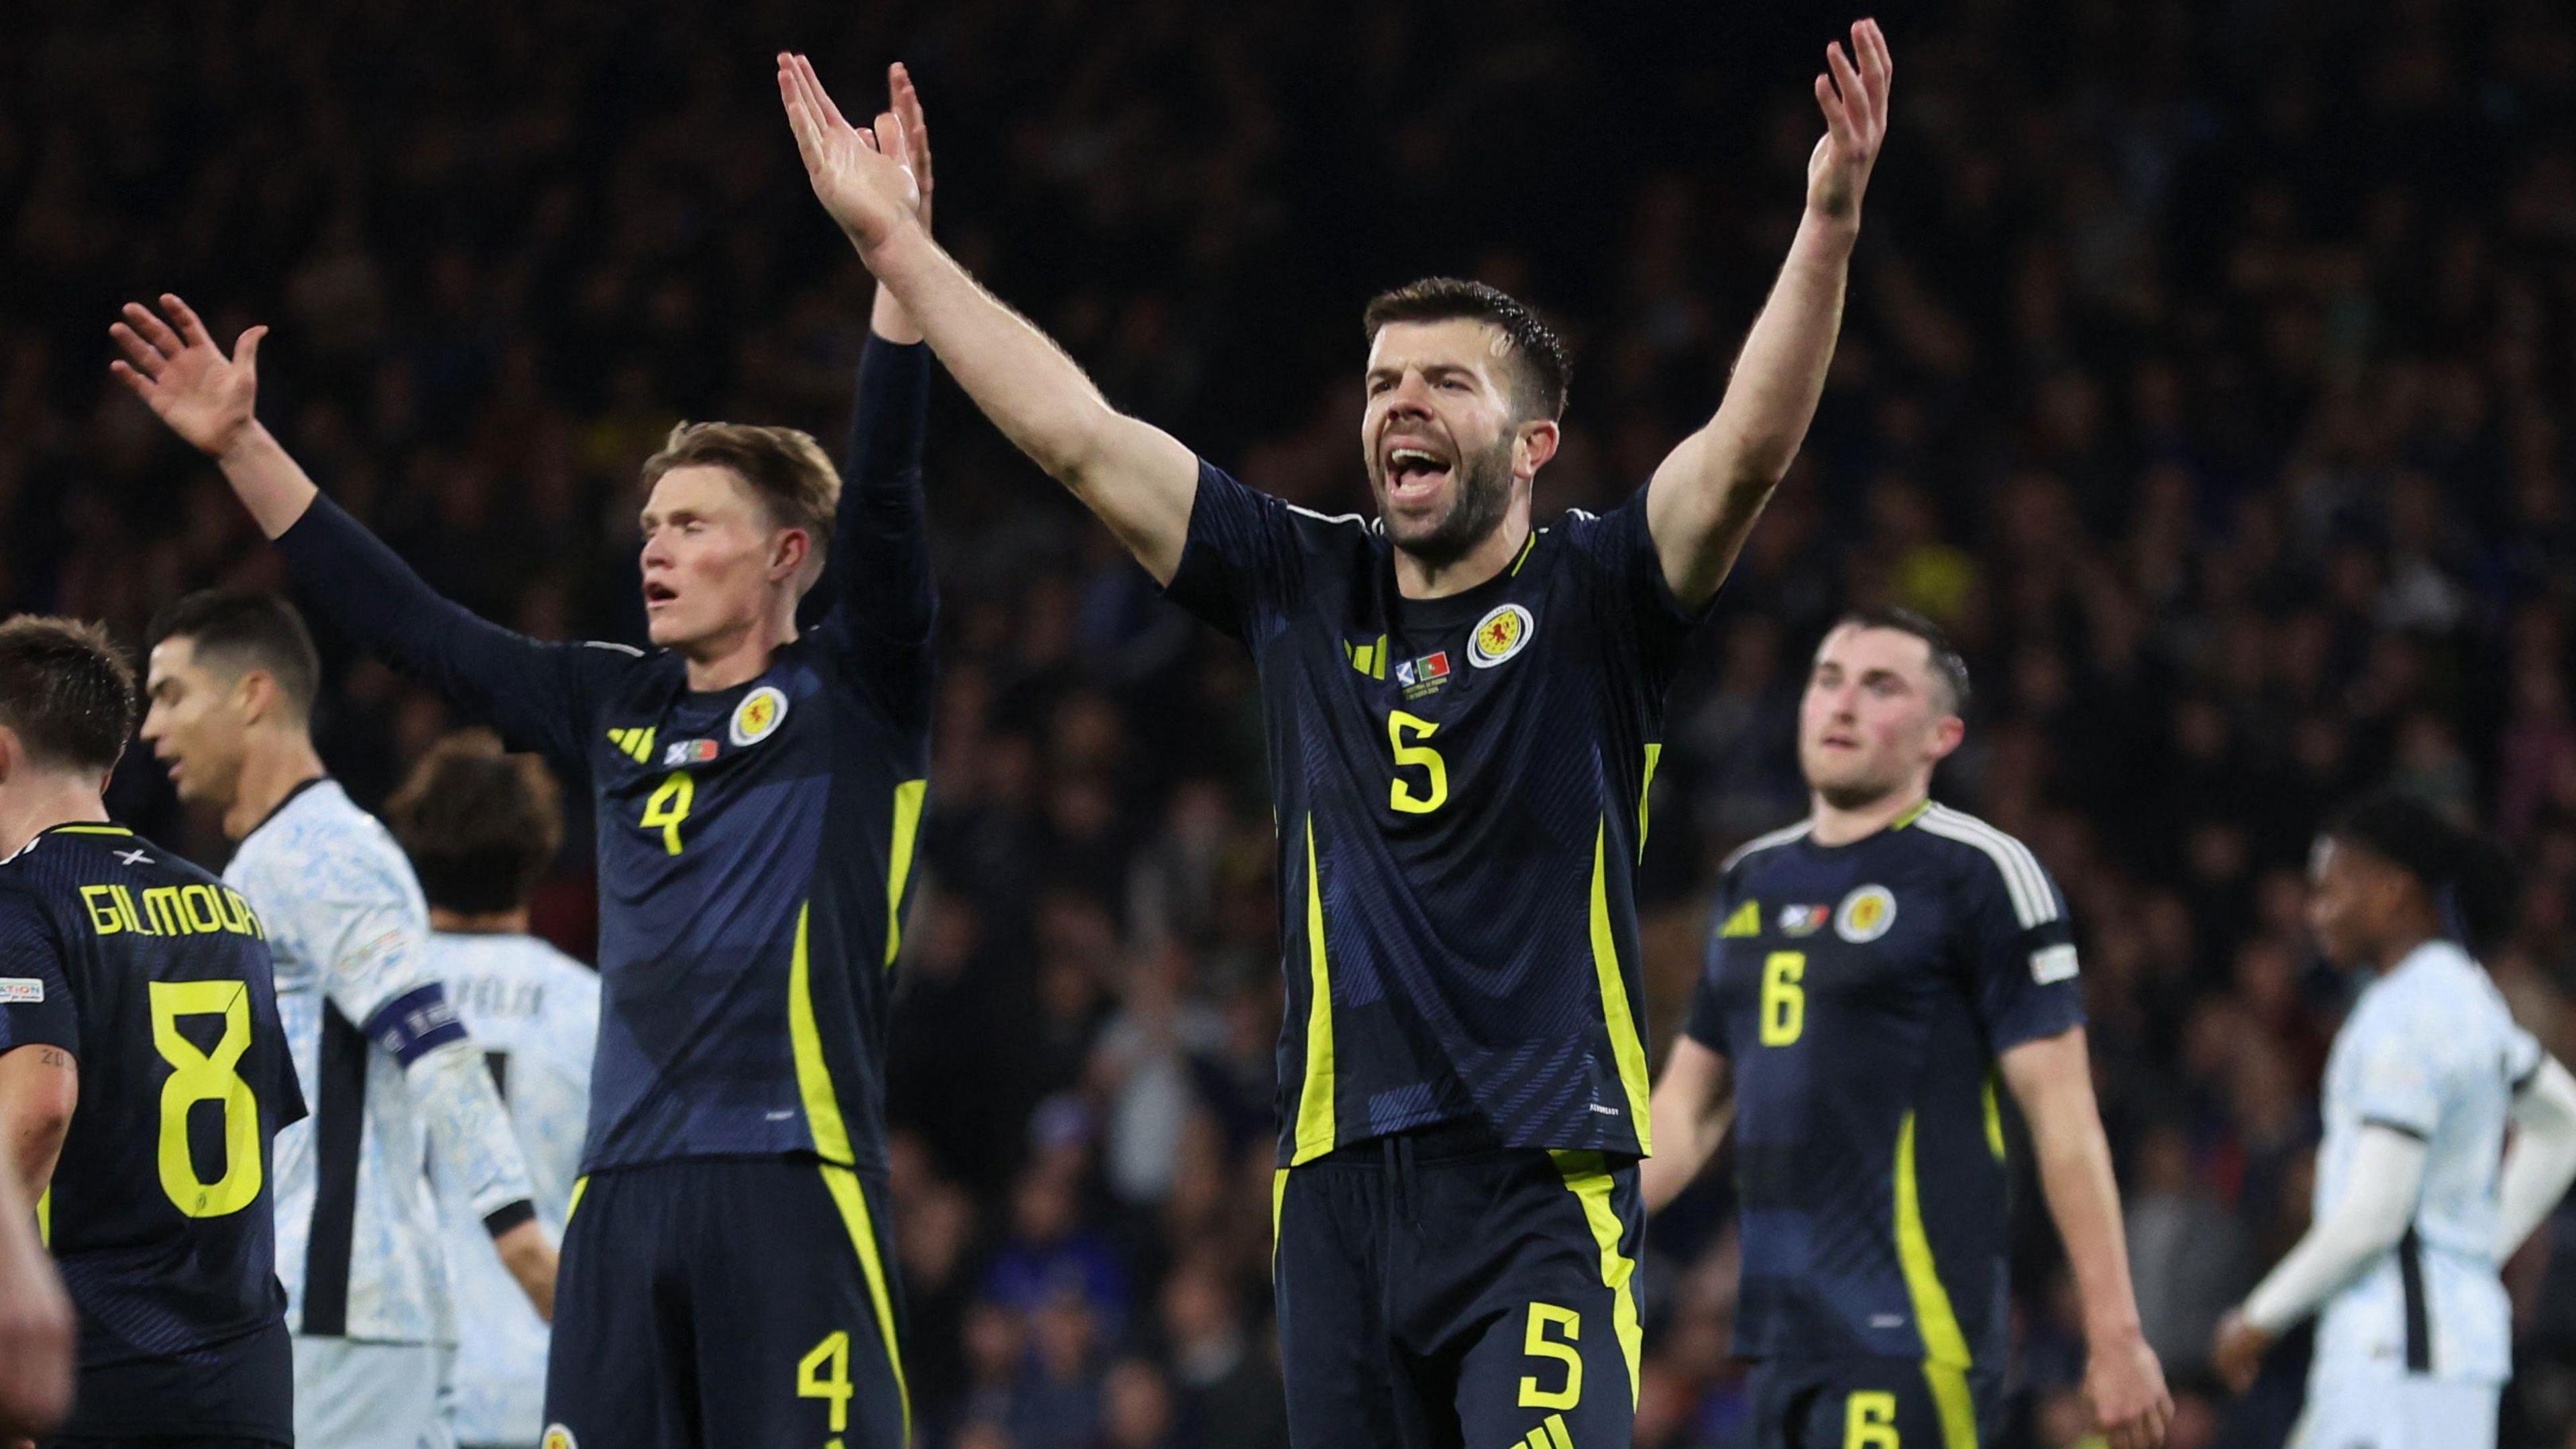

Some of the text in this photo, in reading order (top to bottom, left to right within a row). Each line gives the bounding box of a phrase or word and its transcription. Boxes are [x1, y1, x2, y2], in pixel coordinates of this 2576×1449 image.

[1388, 710, 1448, 814] 5
[639, 772, 694, 856] 4
[80, 884, 264, 941] GILMOUR
[1761, 951, 1806, 1046] 6
[149, 980, 262, 1218] 8
[797, 1331, 853, 1432] 4
[1517, 1301, 1582, 1410] 5
